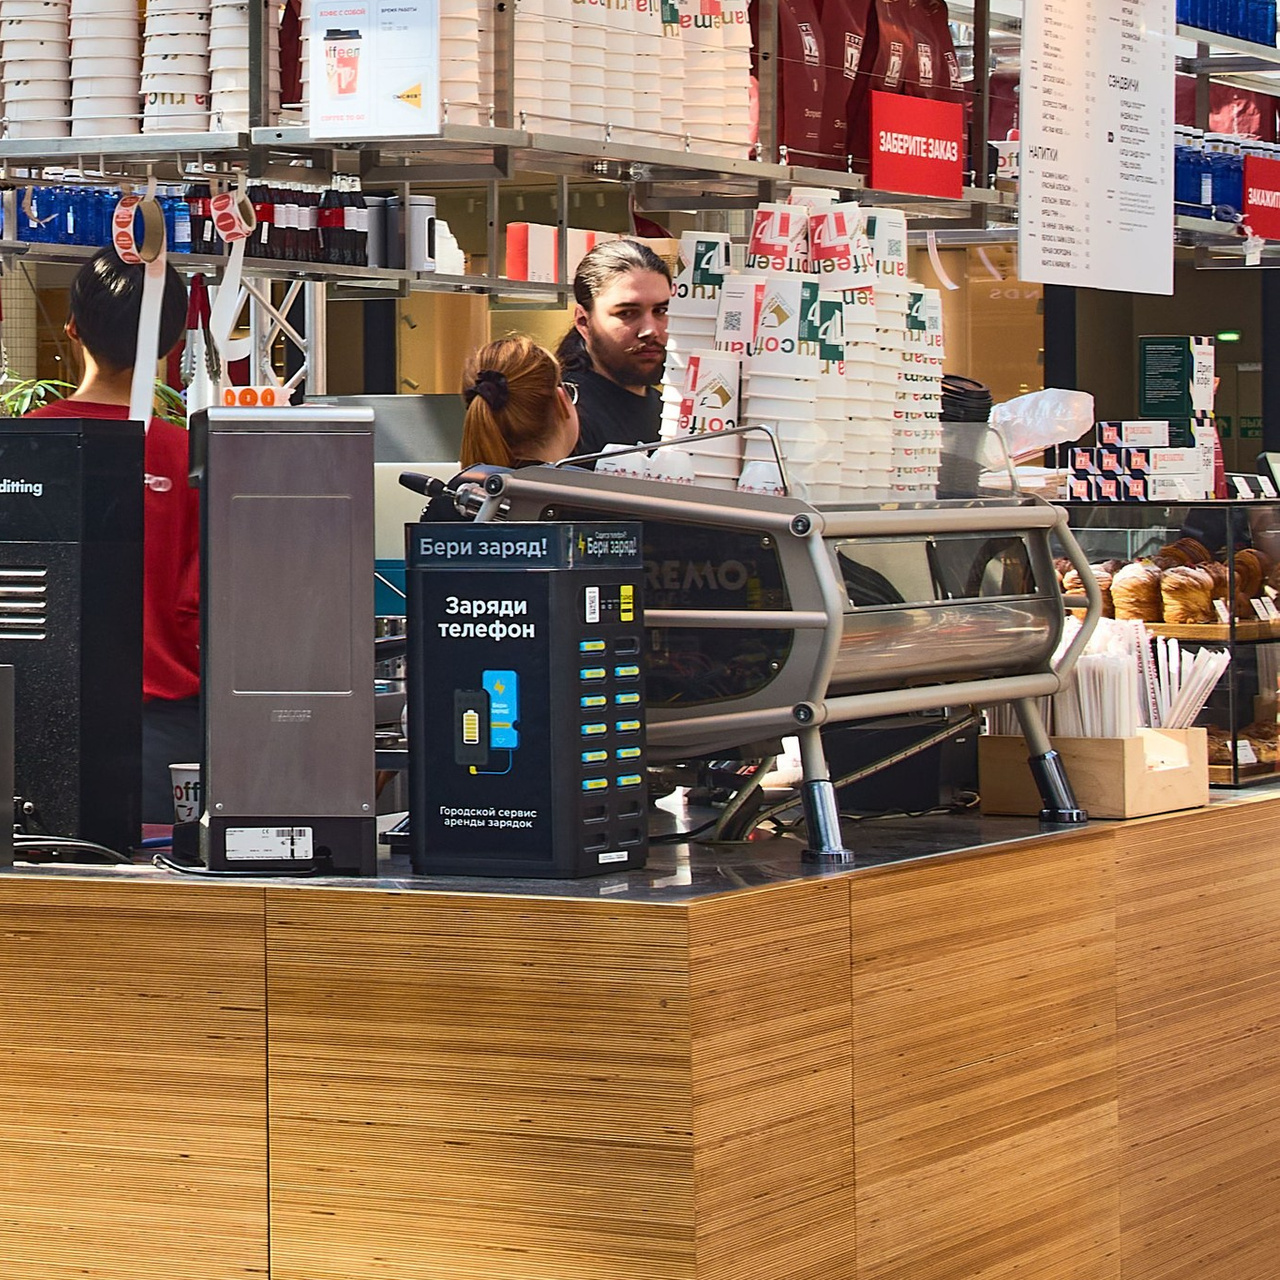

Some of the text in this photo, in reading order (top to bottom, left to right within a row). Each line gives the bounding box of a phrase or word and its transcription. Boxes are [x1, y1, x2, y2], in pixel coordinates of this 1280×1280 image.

[879, 131, 958, 162] ЗАБЕРИТЕ ЗАКАЗ
[420, 538, 547, 558] Бери заряд!
[587, 538, 609, 557] Бери
[445, 597, 527, 617] Заряди
[438, 620, 535, 641] телефон
[440, 806, 537, 818] Городской сервис
[444, 818, 533, 829] аренды зарядок
